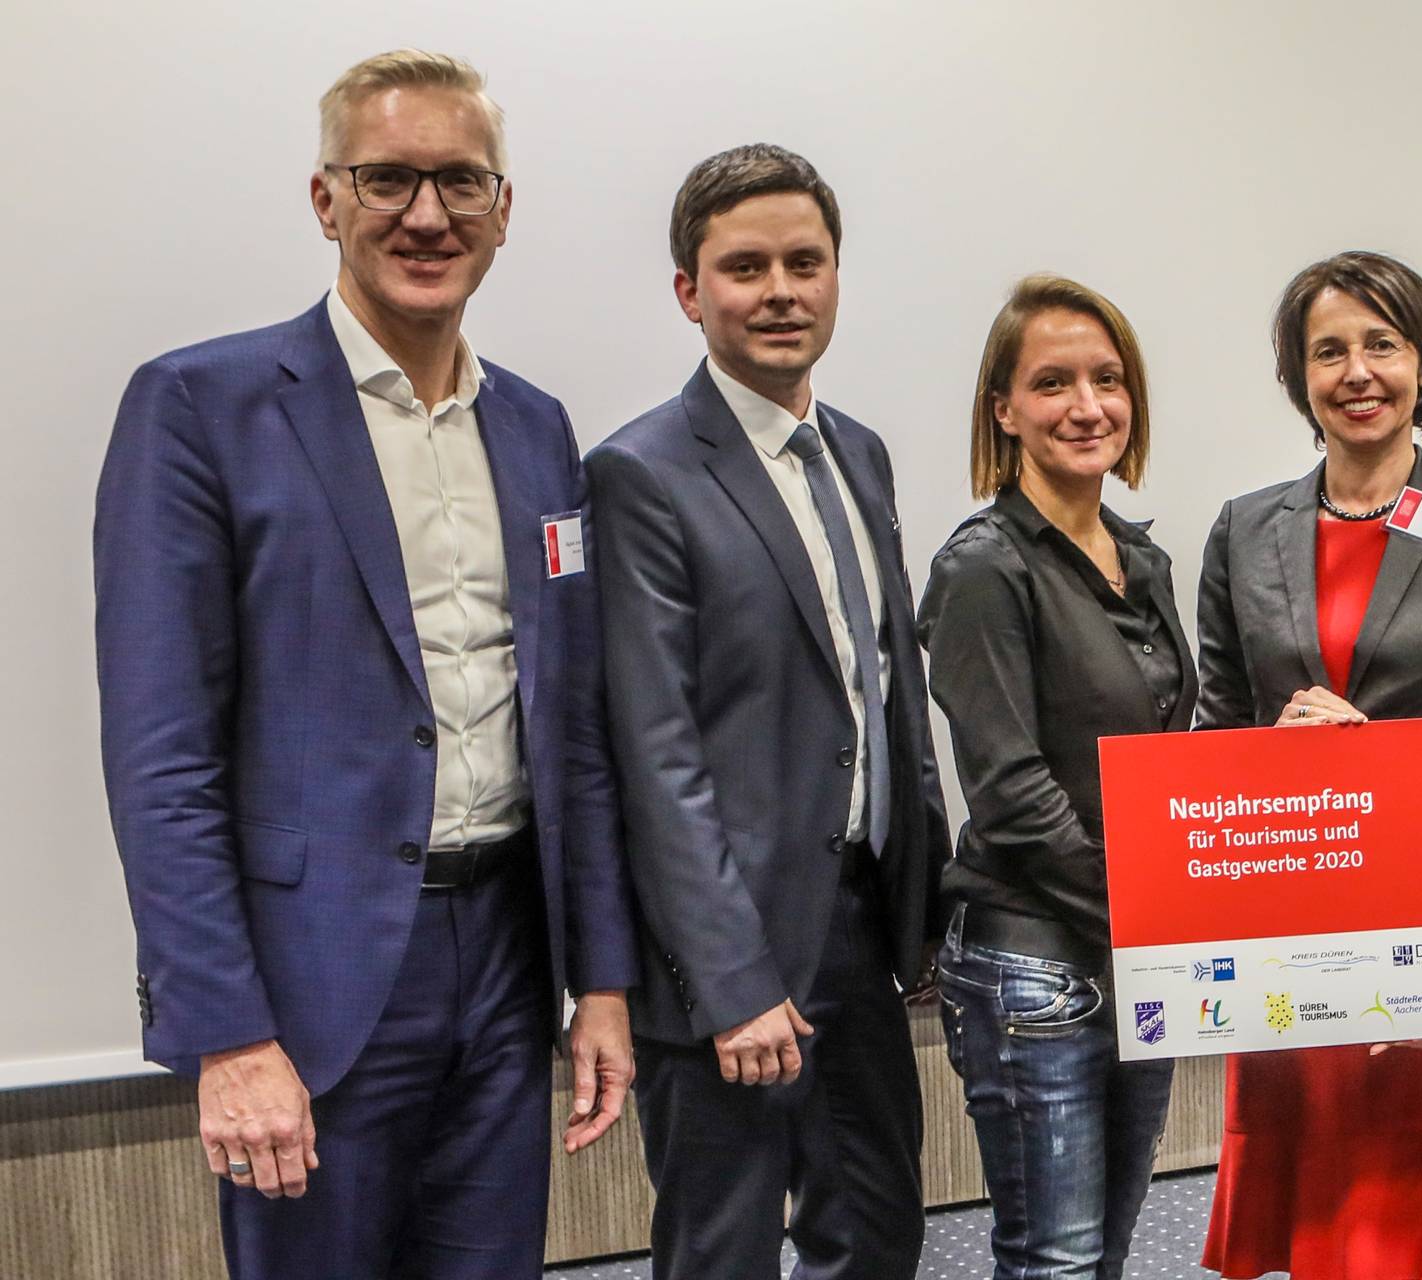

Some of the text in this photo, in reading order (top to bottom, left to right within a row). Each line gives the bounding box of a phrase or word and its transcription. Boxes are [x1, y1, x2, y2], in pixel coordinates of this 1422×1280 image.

[1169, 788, 1373, 823] Neujahrsempfang
[1187, 820, 1359, 849] für Tourismus und
[1187, 850, 1364, 880] Gastgewerbe 2020
[1291, 953, 1318, 961] KREIS
[1320, 950, 1354, 959] DÜREN
[1214, 961, 1232, 971] IHK
[1299, 1002, 1328, 1013] DÜREN
[1299, 1011, 1348, 1022] TOURISMUS
